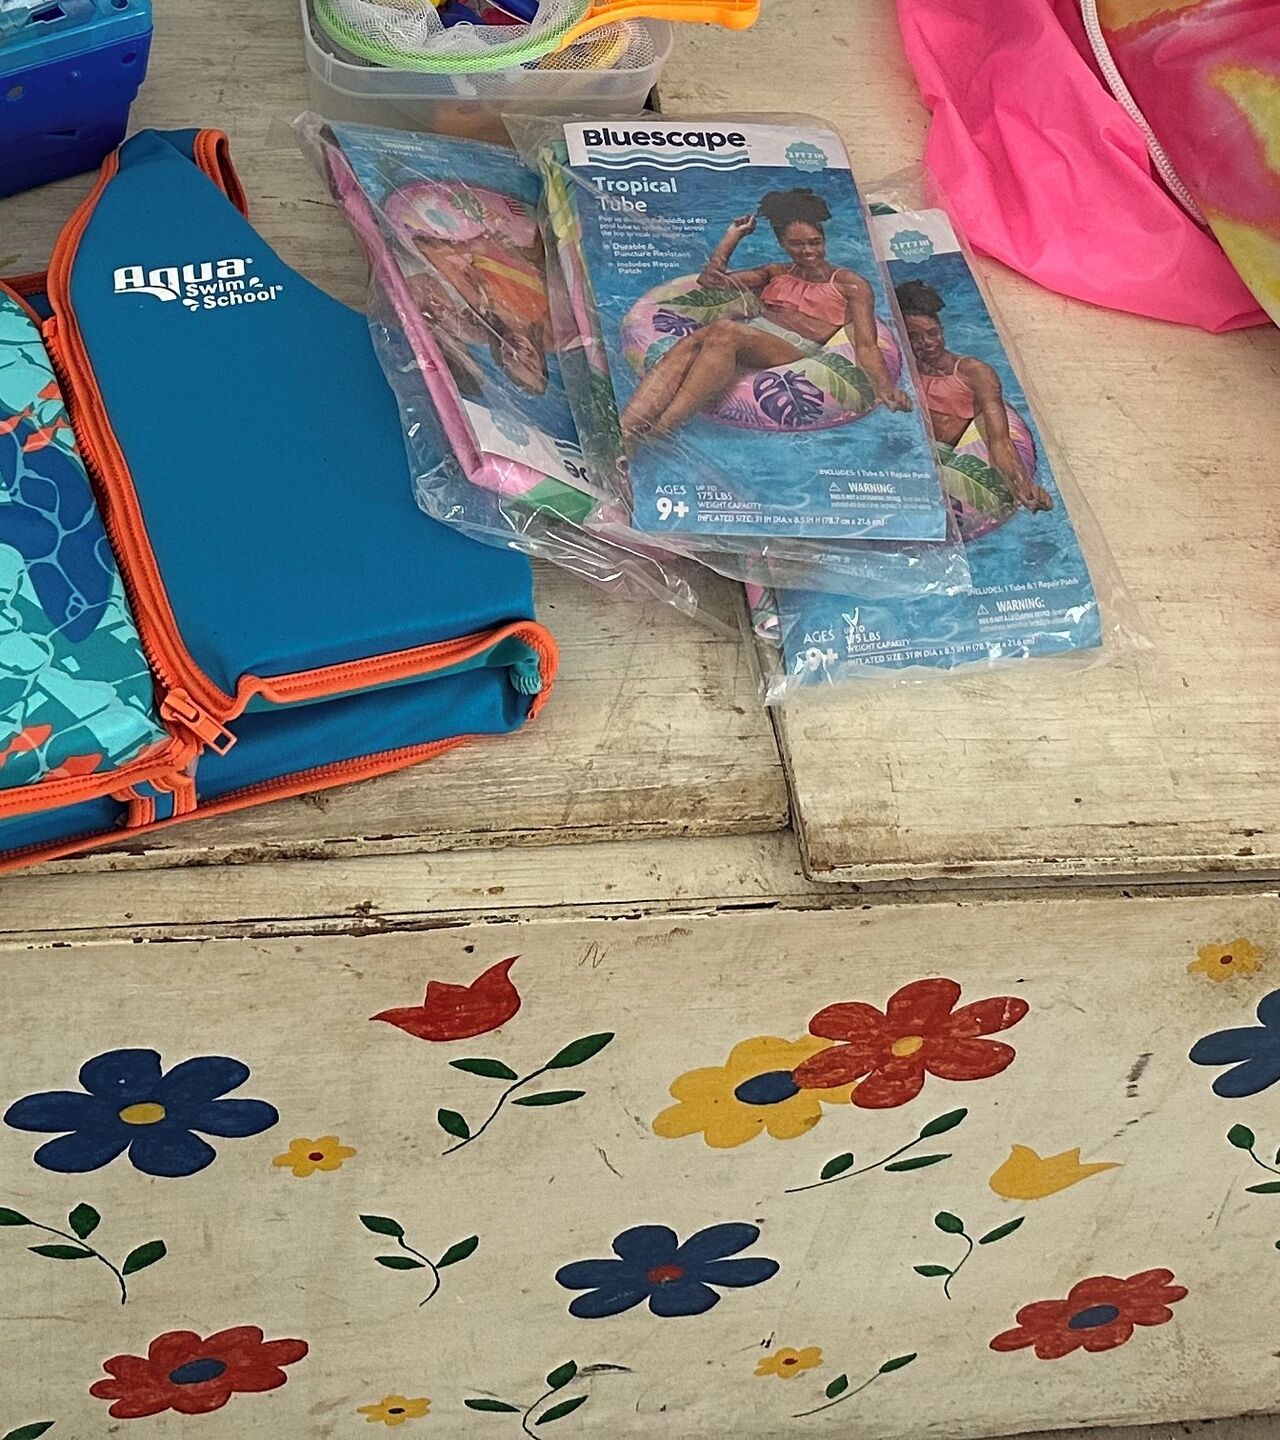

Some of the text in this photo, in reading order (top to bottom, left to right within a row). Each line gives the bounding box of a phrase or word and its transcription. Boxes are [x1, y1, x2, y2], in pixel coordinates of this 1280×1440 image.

[583, 128, 746, 151] Bluescape
[591, 176, 678, 196] Tropical
[596, 196, 648, 212] Tube
[114, 258, 246, 297] Aqua
[186, 279, 245, 297] Swim
[203, 286, 277, 309] School
[655, 484, 686, 495] AGES
[847, 482, 896, 493] WARNING:
[697, 492, 733, 500] 175 LBS
[656, 497, 689, 521] 9+
[697, 501, 726, 509] WEIGHT
[697, 514, 734, 522] INFLATED
[996, 597, 1045, 613] WARNING:
[803, 629, 835, 644] AGES
[863, 631, 881, 643] LBS
[876, 638, 911, 649] CAPACITY
